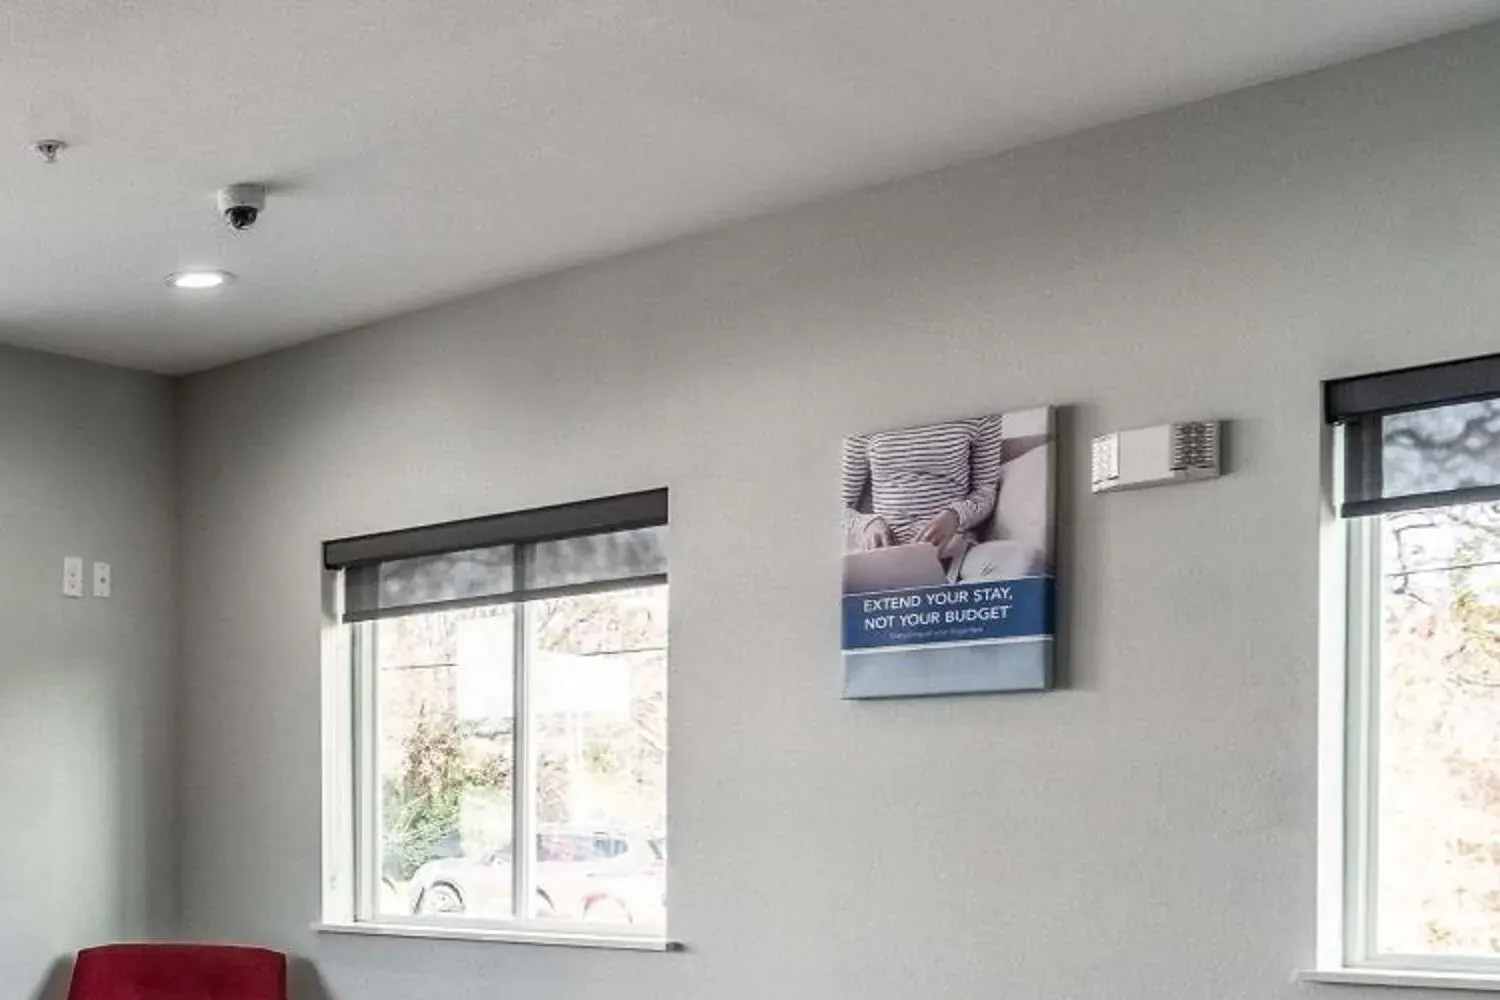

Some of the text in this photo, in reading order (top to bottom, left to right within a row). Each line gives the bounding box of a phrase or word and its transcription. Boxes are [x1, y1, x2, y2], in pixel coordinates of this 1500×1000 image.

[863, 587, 1013, 613] EXTEND YOUR STAY,
[864, 605, 1011, 631] NOT YOUR BUDGET
